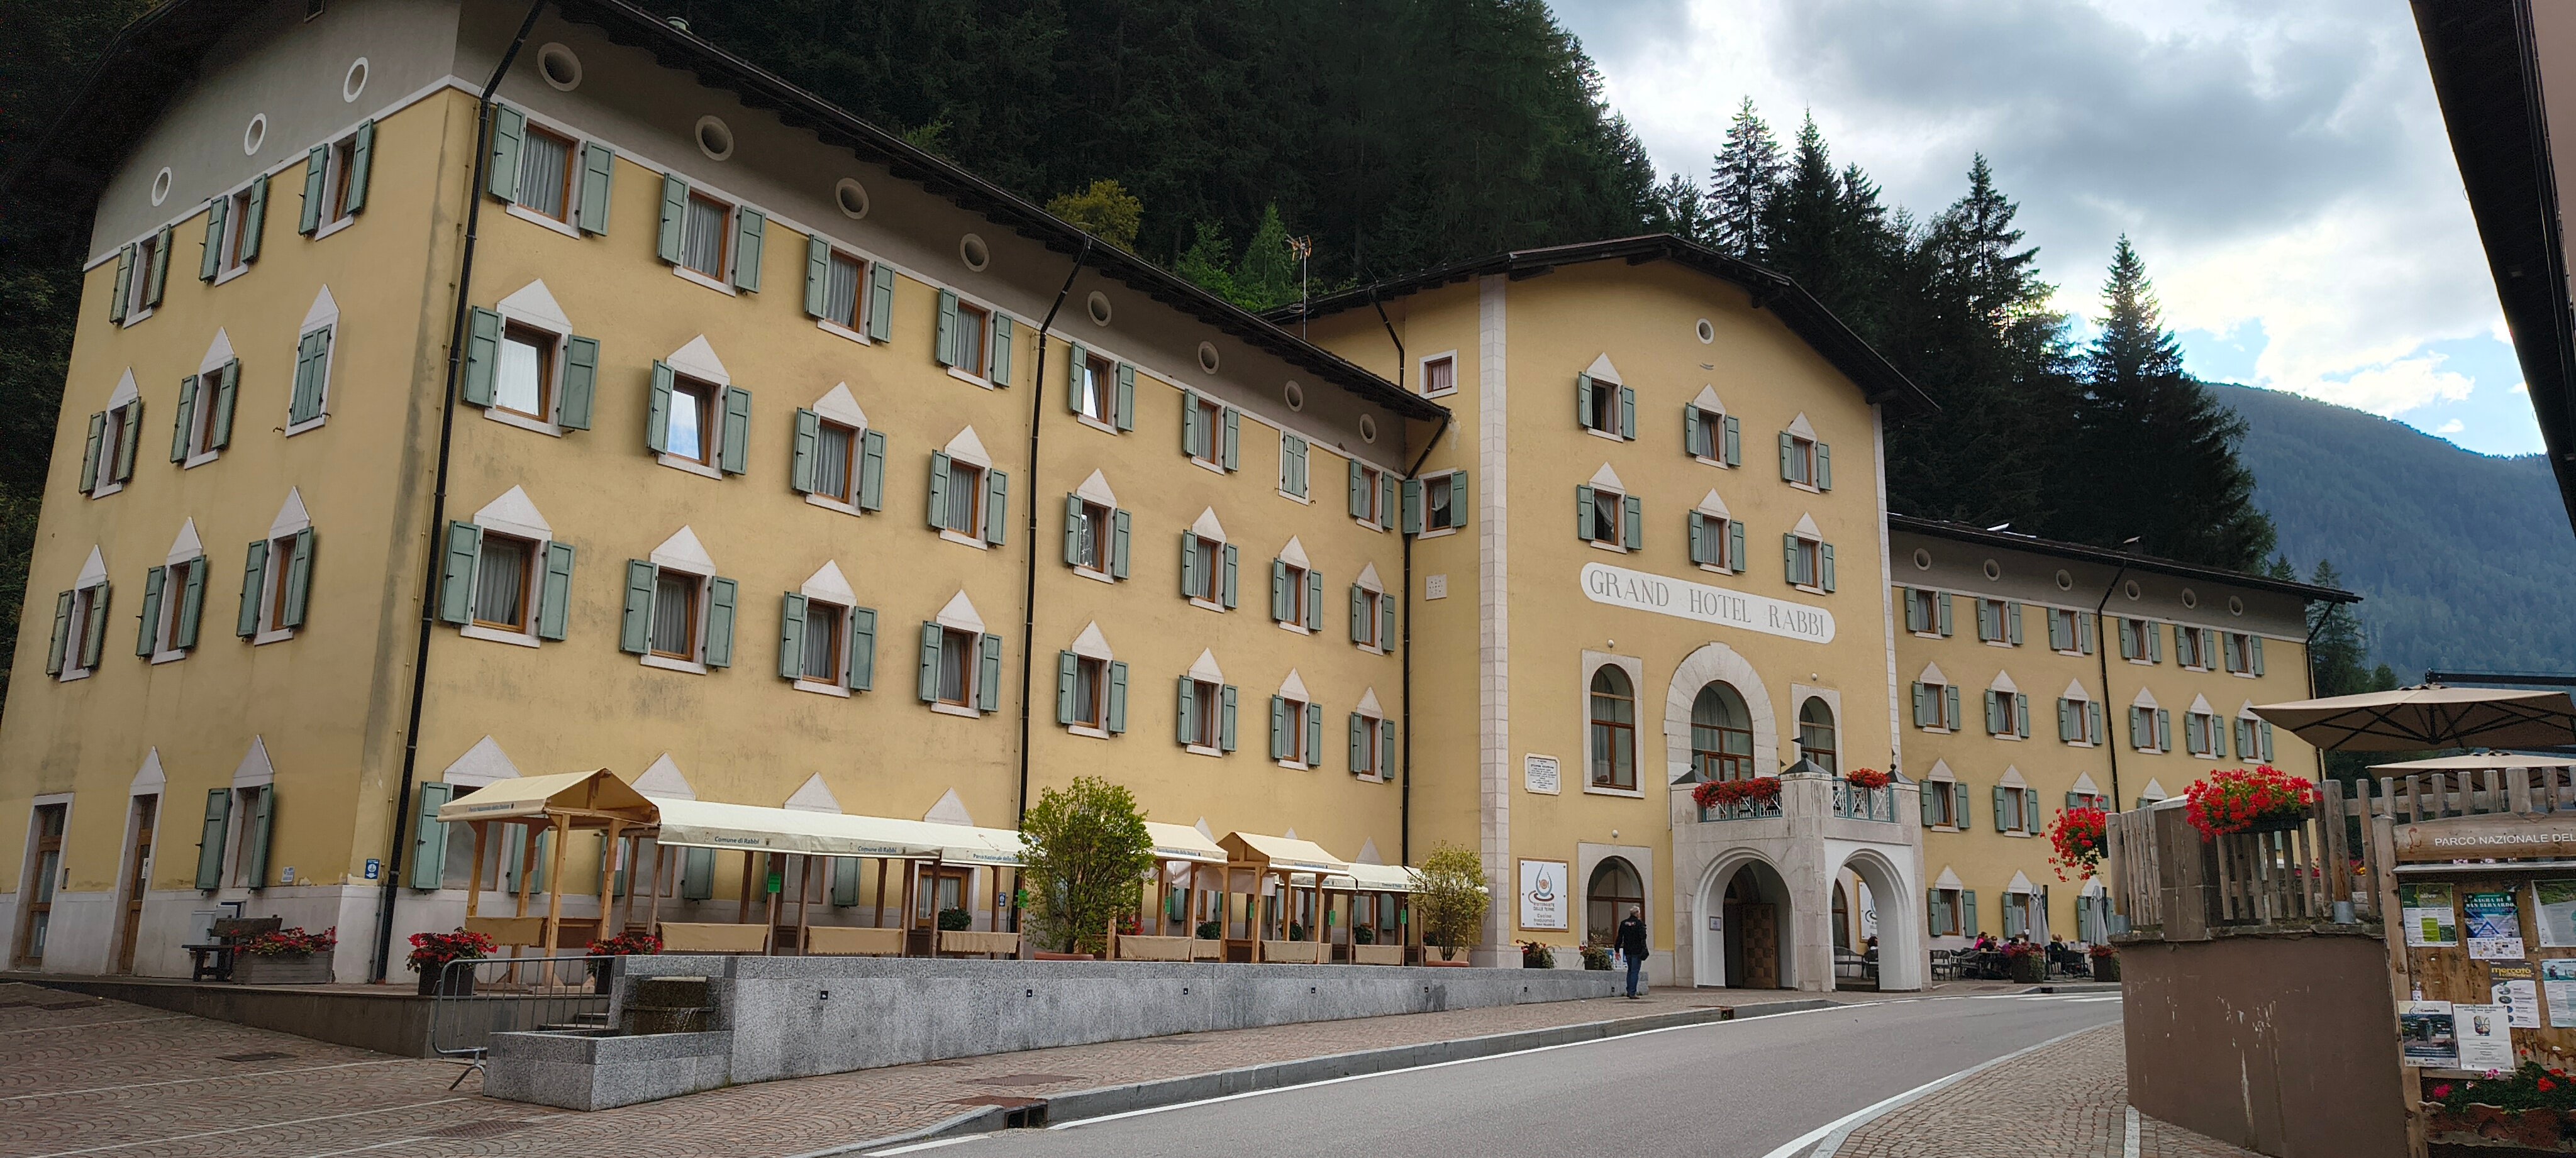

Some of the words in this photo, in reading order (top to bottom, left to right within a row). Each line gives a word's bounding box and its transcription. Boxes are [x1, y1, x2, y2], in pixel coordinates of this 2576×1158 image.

[1590, 570, 1669, 607] GRAND
[1689, 588, 1752, 623] HOTEL
[1769, 604, 1824, 637] RABBI
[2434, 837, 2475, 846] PARCO
[2479, 834, 2549, 845] NAZIONALE
